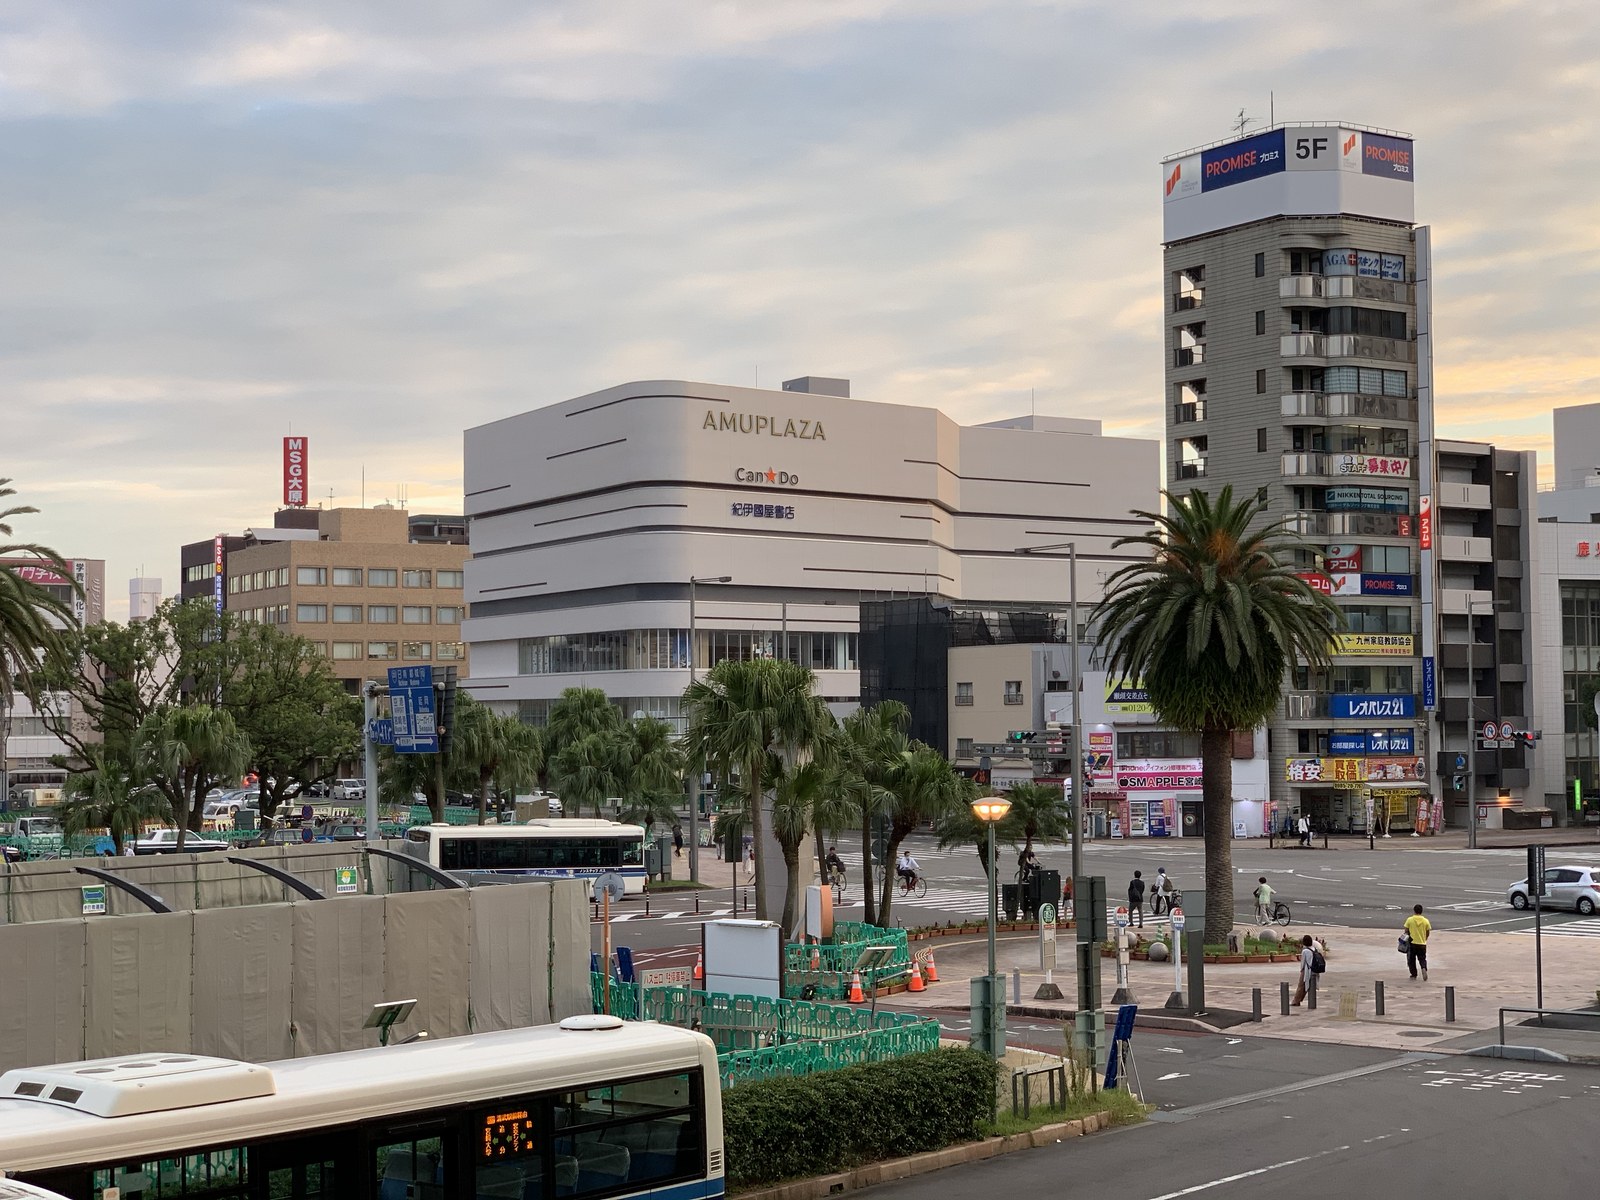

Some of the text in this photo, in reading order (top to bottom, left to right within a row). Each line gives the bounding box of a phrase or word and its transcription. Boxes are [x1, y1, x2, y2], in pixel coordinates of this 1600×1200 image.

[1295, 137, 1329, 160] 5F
[1366, 145, 1409, 164] PROMISE
[1206, 151, 1280, 178] PROMISE プロミス
[1393, 163, 1409, 174] プロミス
[1324, 254, 1348, 267] AGA
[1357, 255, 1403, 271] スキンクリニック
[702, 410, 827, 441] AMUPLAZA
[288, 438, 303, 503] MSG大原
[1337, 491, 1403, 501] NIKKEN TOTAL SOURCING
[731, 502, 795, 520] 紀伊國屋書店
[1422, 518, 1430, 541] アコム
[1330, 559, 1358, 570] アコム
[1365, 579, 1395, 590] PROMISE
[1356, 635, 1411, 646] 九州家庭教師協会
[1349, 697, 1404, 716] レオパレス21
[1371, 738, 1409, 751] レオパレス21
[1288, 763, 1321, 781] 格安
